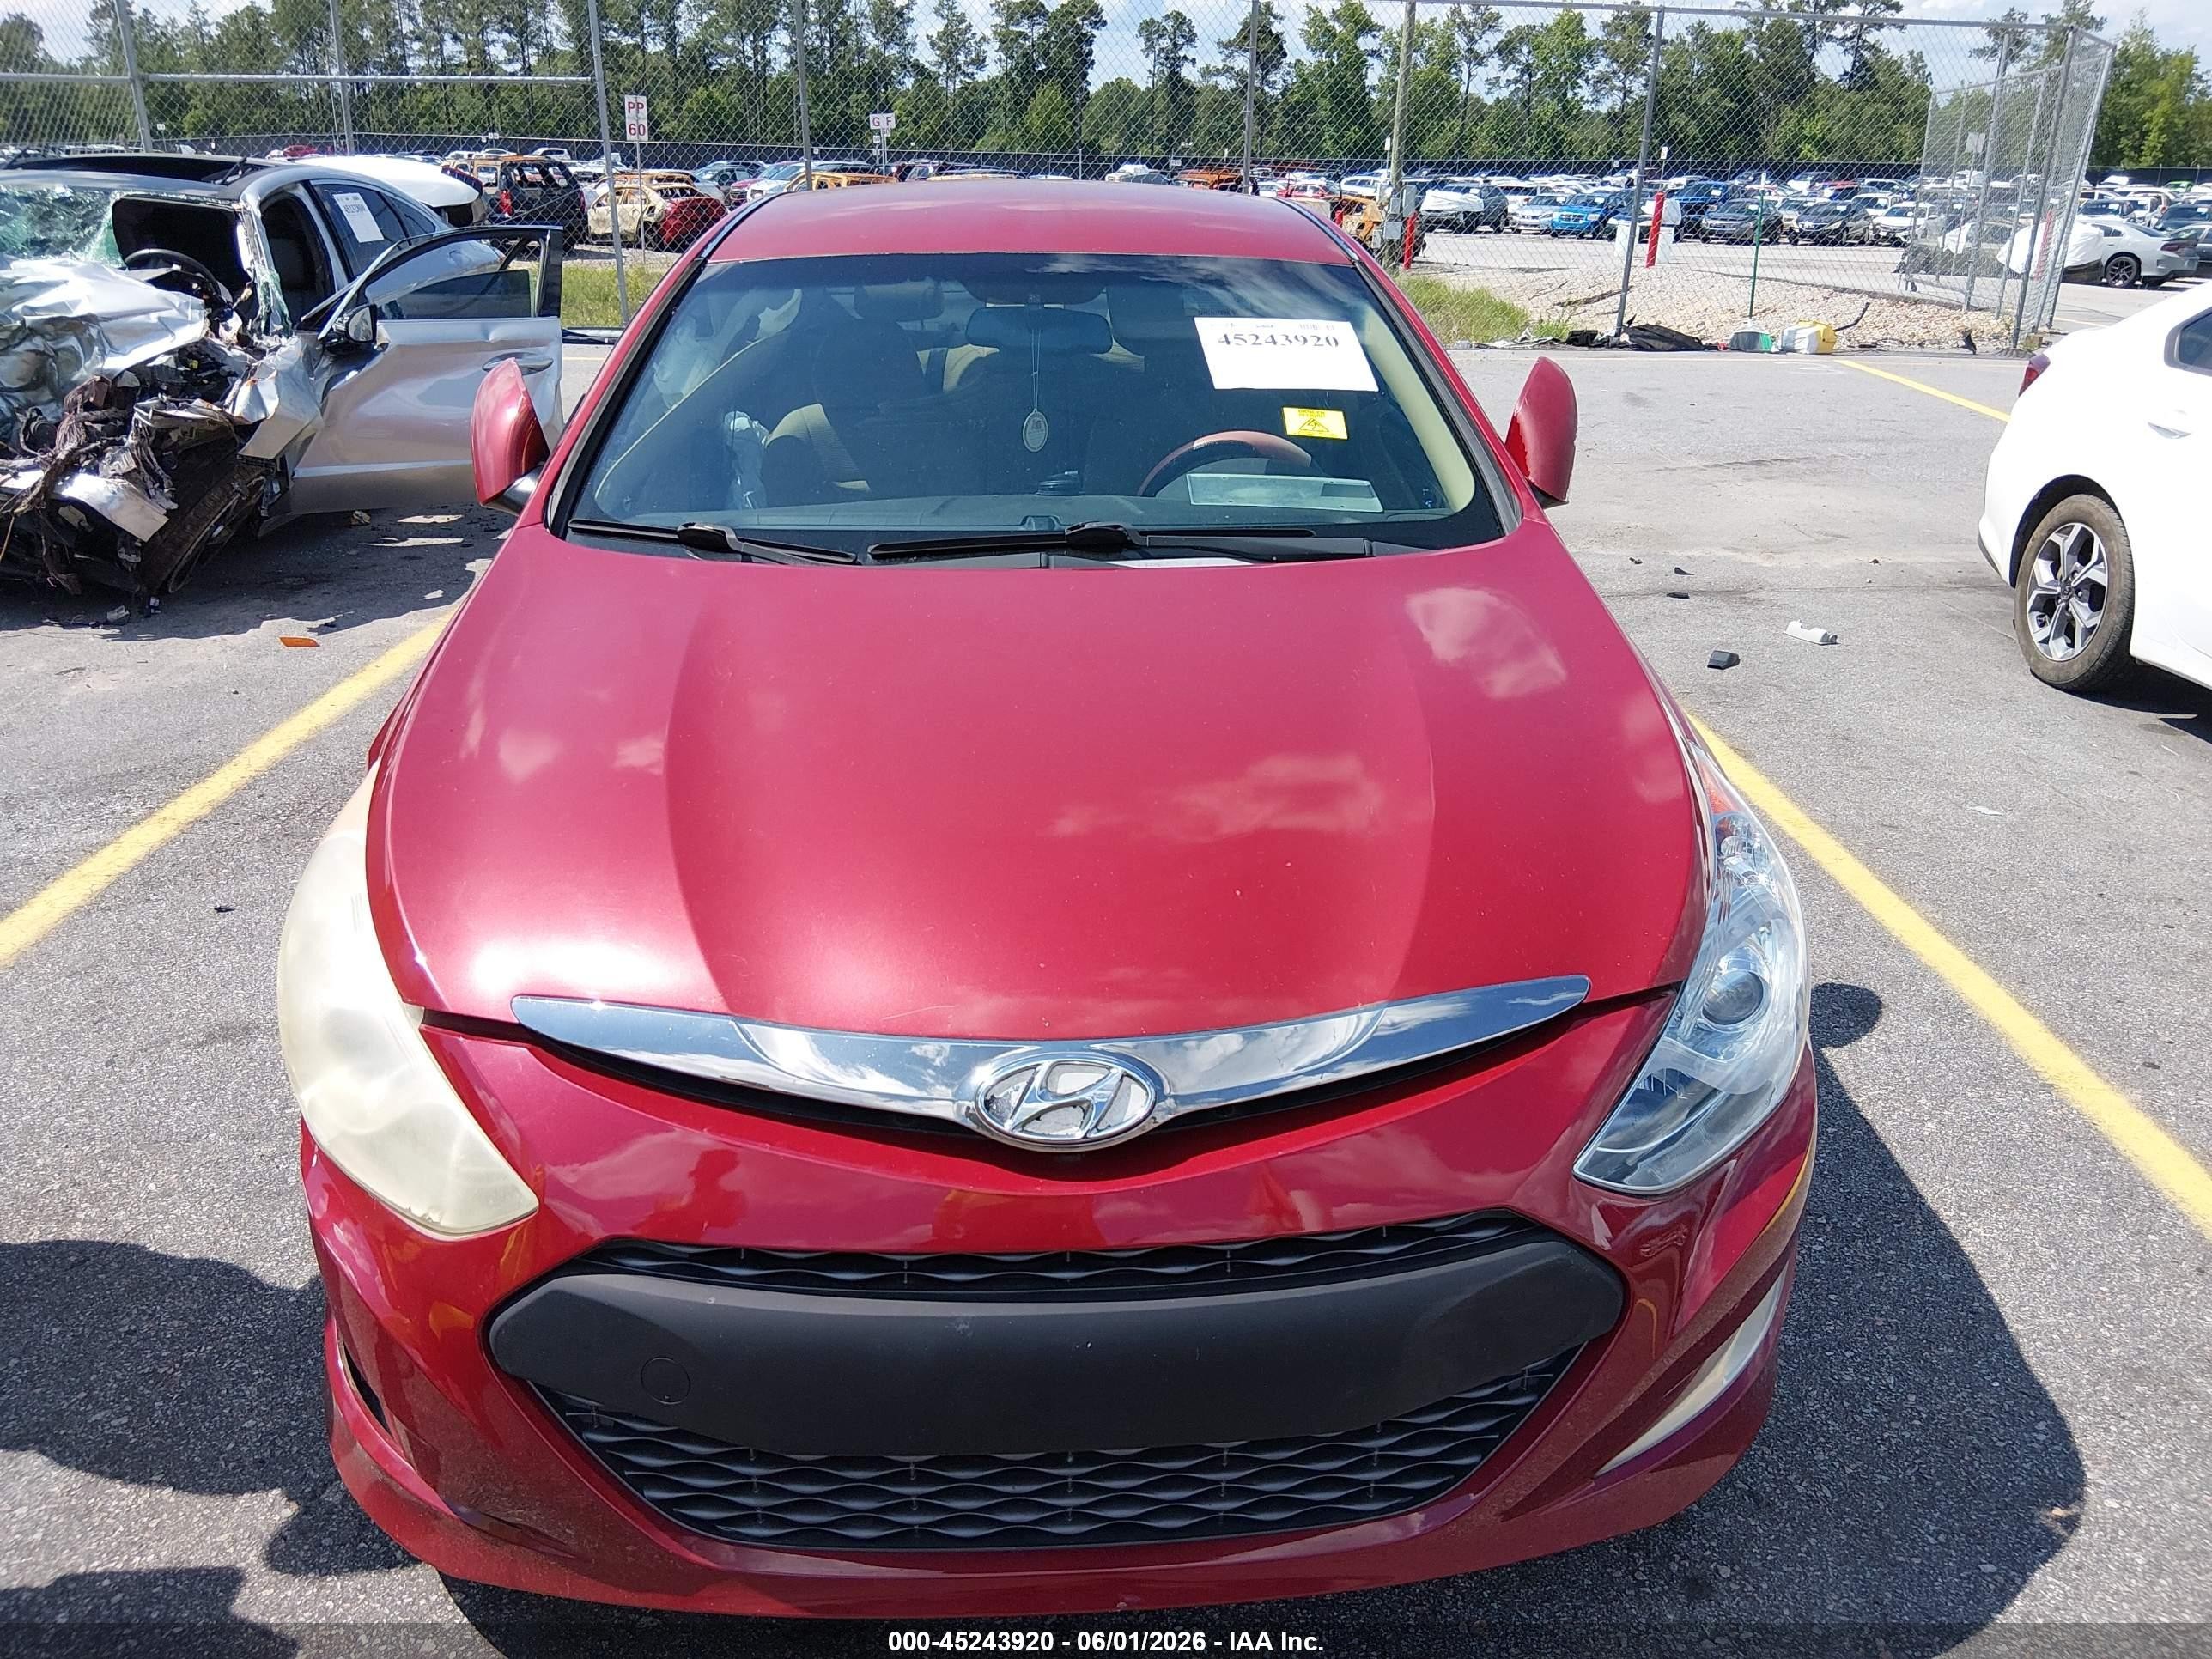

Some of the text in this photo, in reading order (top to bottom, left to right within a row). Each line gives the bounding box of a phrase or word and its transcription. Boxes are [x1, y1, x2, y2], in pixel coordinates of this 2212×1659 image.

[628, 101, 644, 113] PP
[872, 116, 892, 127] G F
[629, 123, 646, 136] 60
[1218, 332, 1339, 348] 45243920
